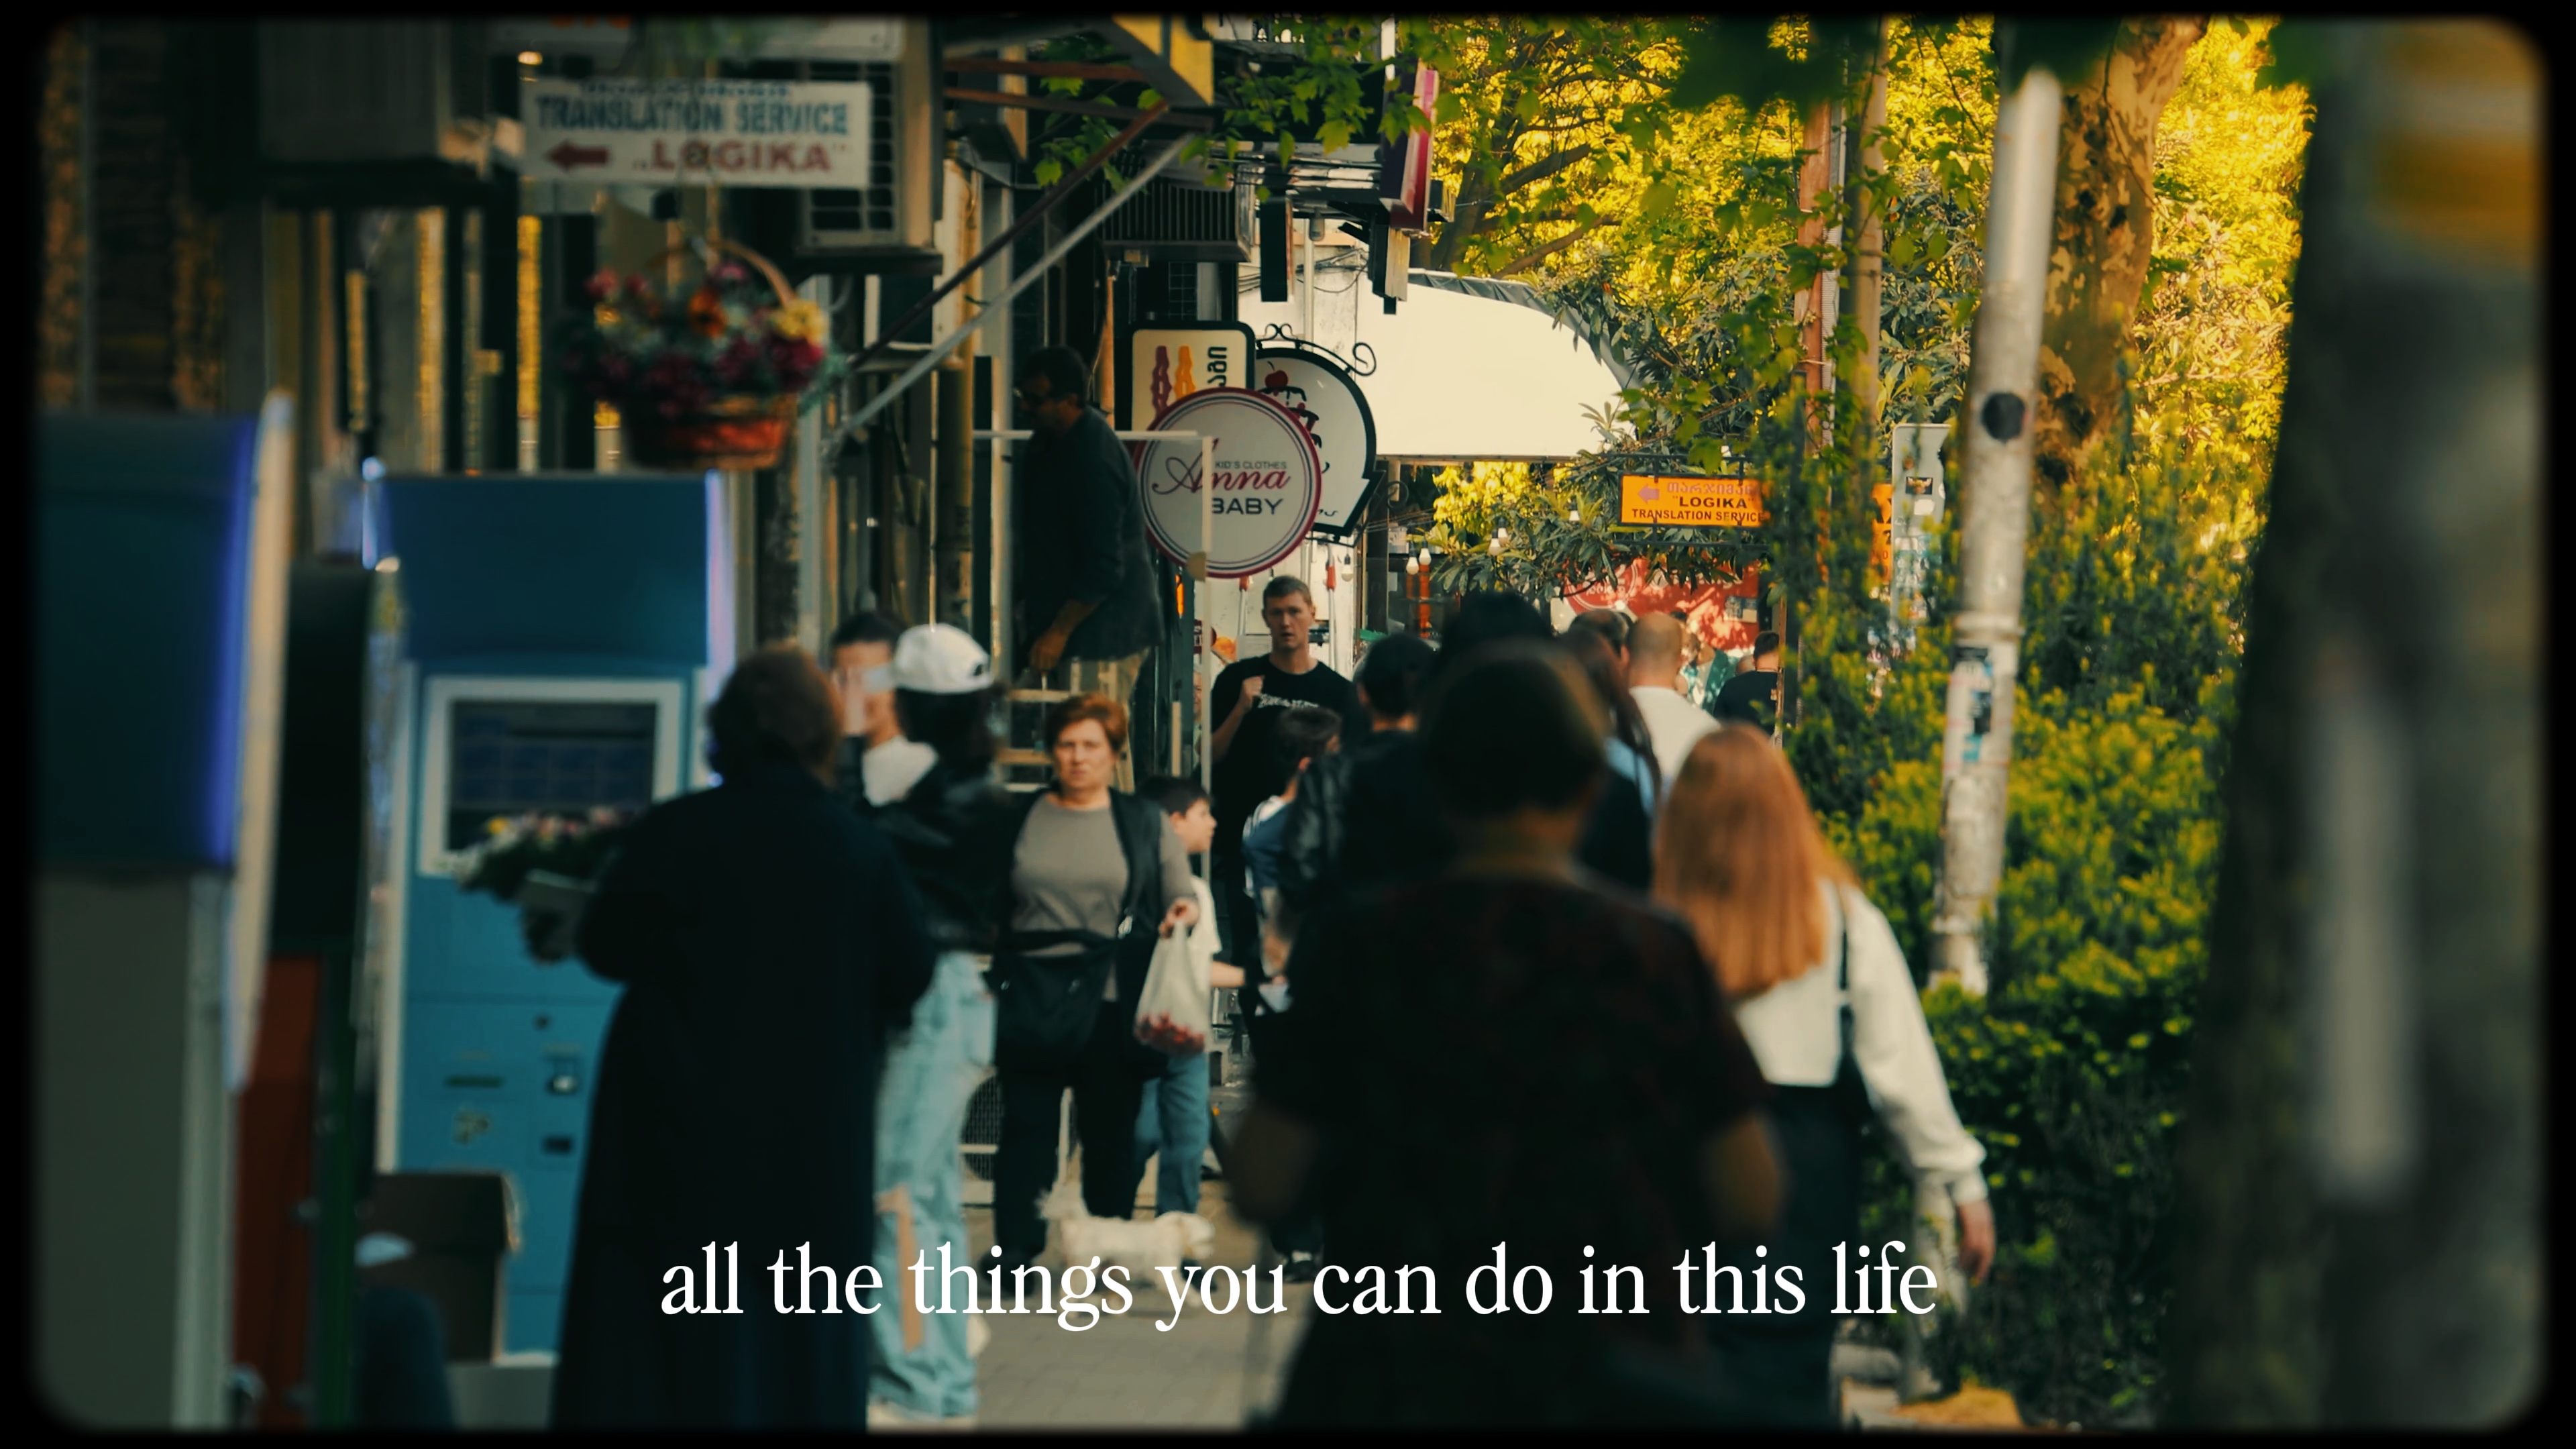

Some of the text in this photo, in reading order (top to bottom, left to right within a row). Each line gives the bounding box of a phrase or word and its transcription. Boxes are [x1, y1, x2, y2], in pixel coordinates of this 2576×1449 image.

[536, 96, 849, 135] TRANSLATION SERVICE
[1152, 438, 1291, 495] Anna
[1215, 461, 1287, 470] KID'S CLOTHES
[1632, 508, 1712, 521] TRANSLATION
